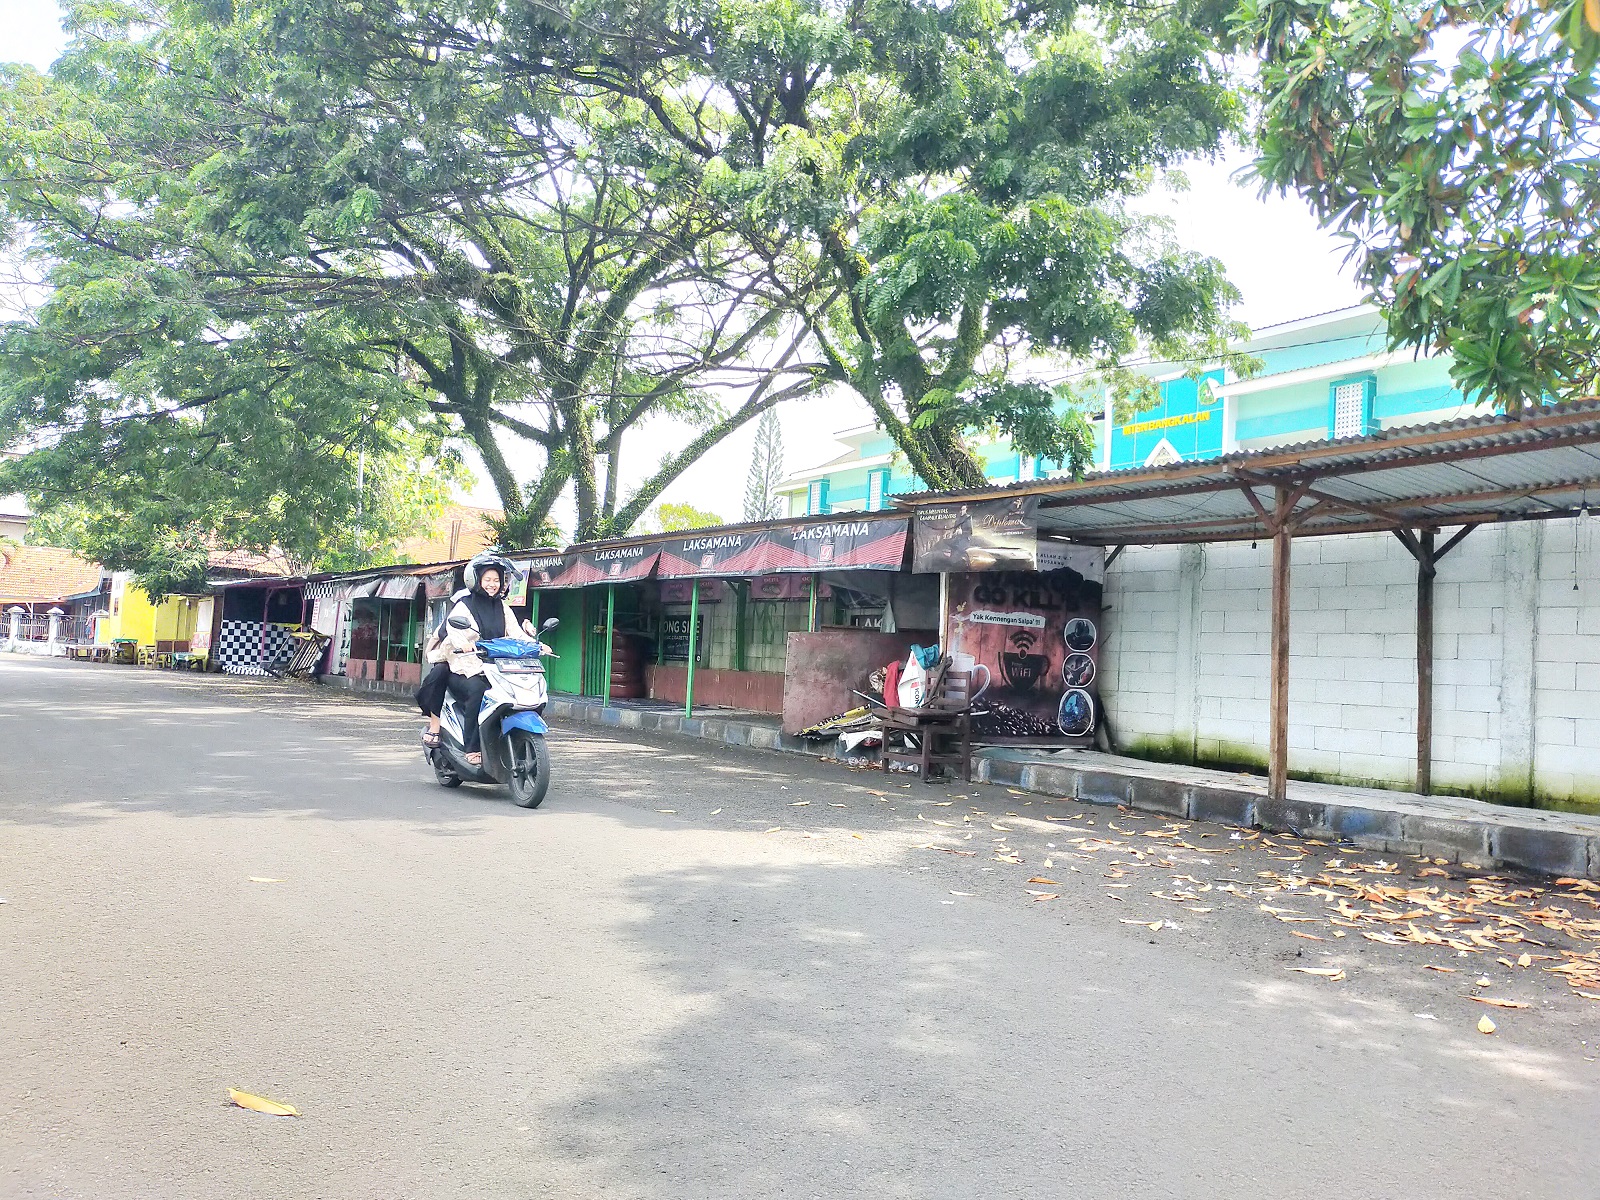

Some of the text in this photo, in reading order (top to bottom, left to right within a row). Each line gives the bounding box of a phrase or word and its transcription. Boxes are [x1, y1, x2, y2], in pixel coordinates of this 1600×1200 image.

[1149, 411, 1210, 430] BANGKALAN
[792, 523, 869, 541] LAKSAMANA
[683, 535, 742, 551] LAKSAMANA
[594, 547, 643, 561] LAKSAMANA
[531, 557, 564, 568] KSAMANA
[973, 613, 984, 621] Yak
[984, 614, 1018, 624] Kennengan
[663, 620, 680, 633] ONG
[1011, 667, 1031, 677] WiFi
